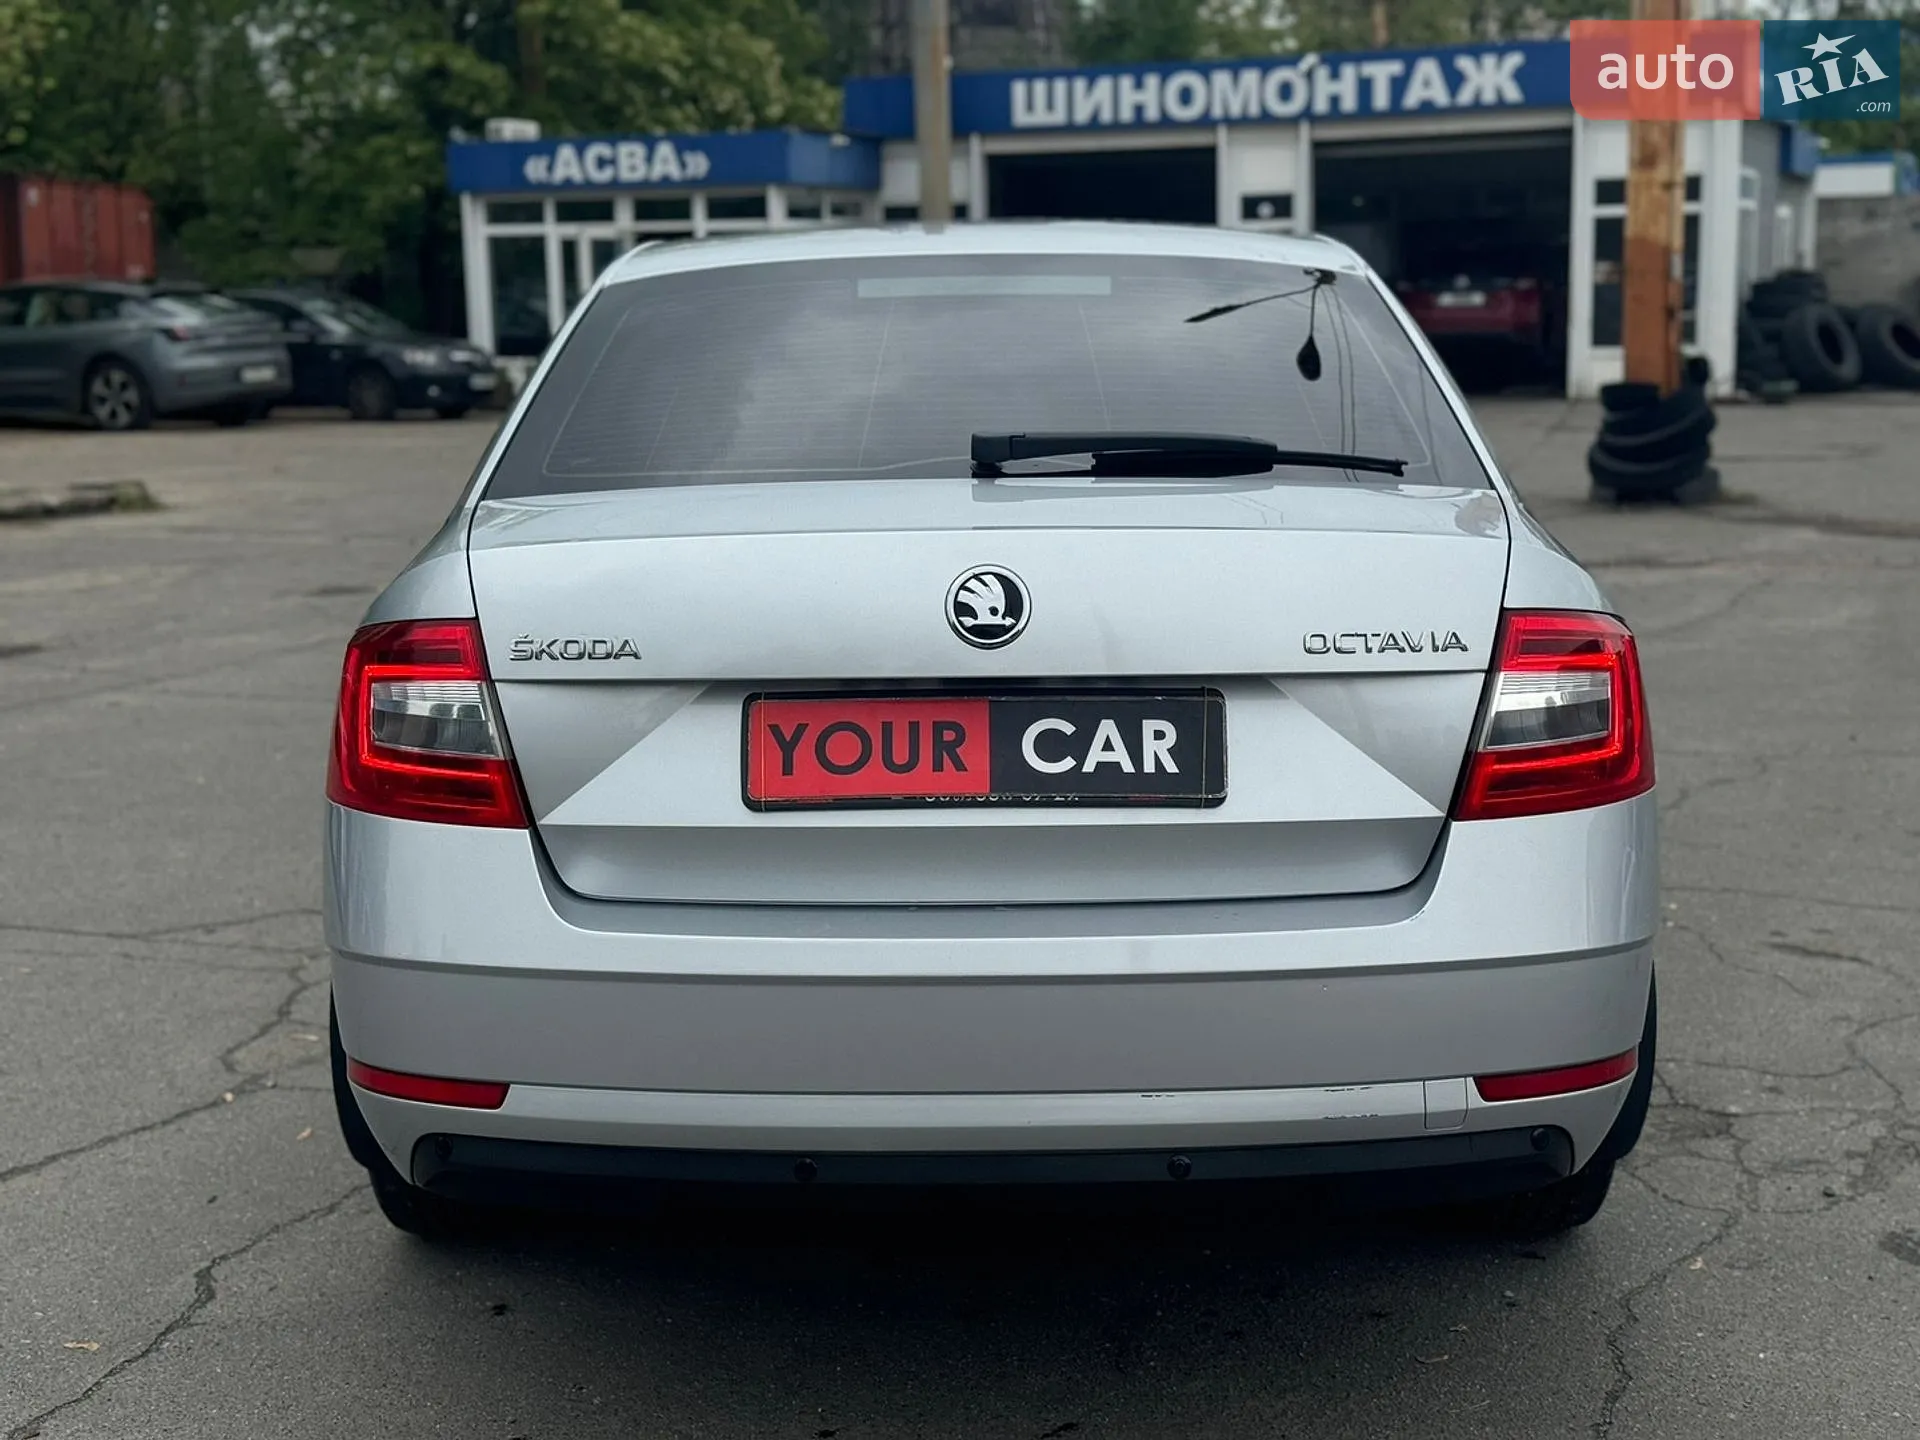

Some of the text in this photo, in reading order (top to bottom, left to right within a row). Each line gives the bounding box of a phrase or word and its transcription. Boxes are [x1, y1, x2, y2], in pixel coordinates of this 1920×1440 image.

[1010, 50, 1526, 129] ШИНОМОНТАЖ
[523, 139, 711, 187] «АСВА»
[509, 634, 642, 661] ŠKODA
[1303, 630, 1469, 655] OCTAVIA
[766, 717, 1180, 777] YOUR CAR
